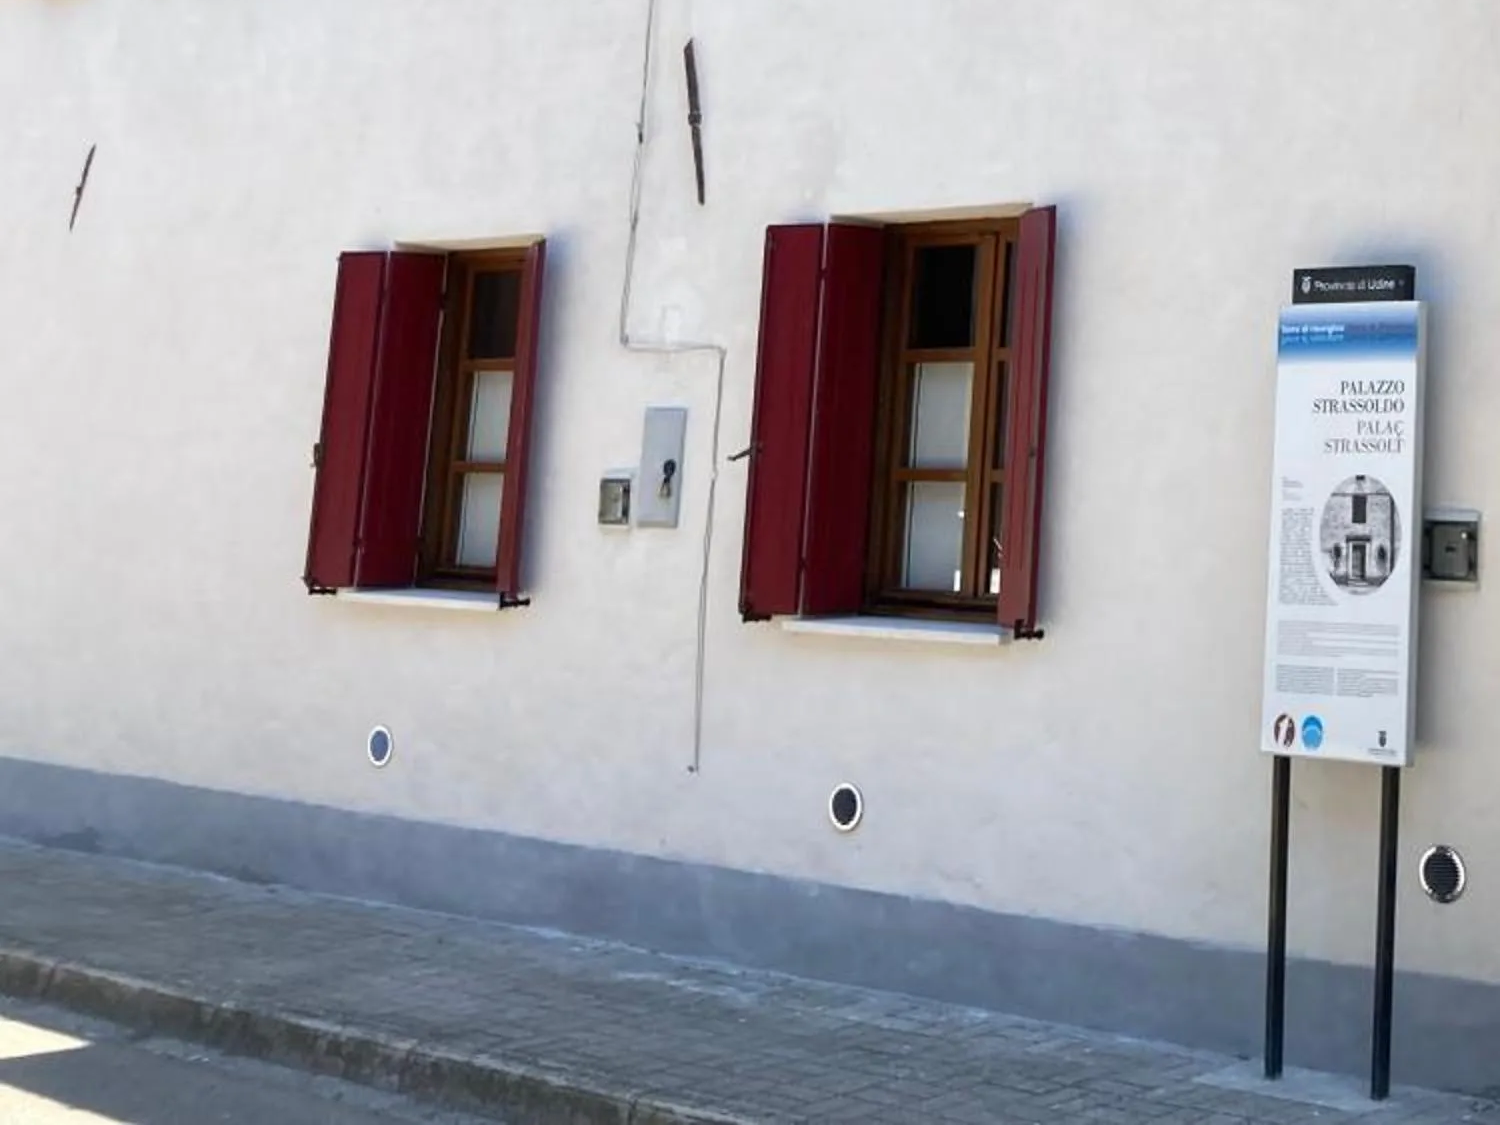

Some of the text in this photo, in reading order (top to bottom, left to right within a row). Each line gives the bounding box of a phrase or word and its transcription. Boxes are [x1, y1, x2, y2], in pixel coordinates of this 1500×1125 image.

[1367, 278, 1396, 290] Udine
[1340, 379, 1405, 396] PALAZZO
[1312, 397, 1405, 415] STRASSOLDO
[1356, 419, 1405, 437] PALAÇ
[1323, 437, 1405, 454] STRASSOLT
